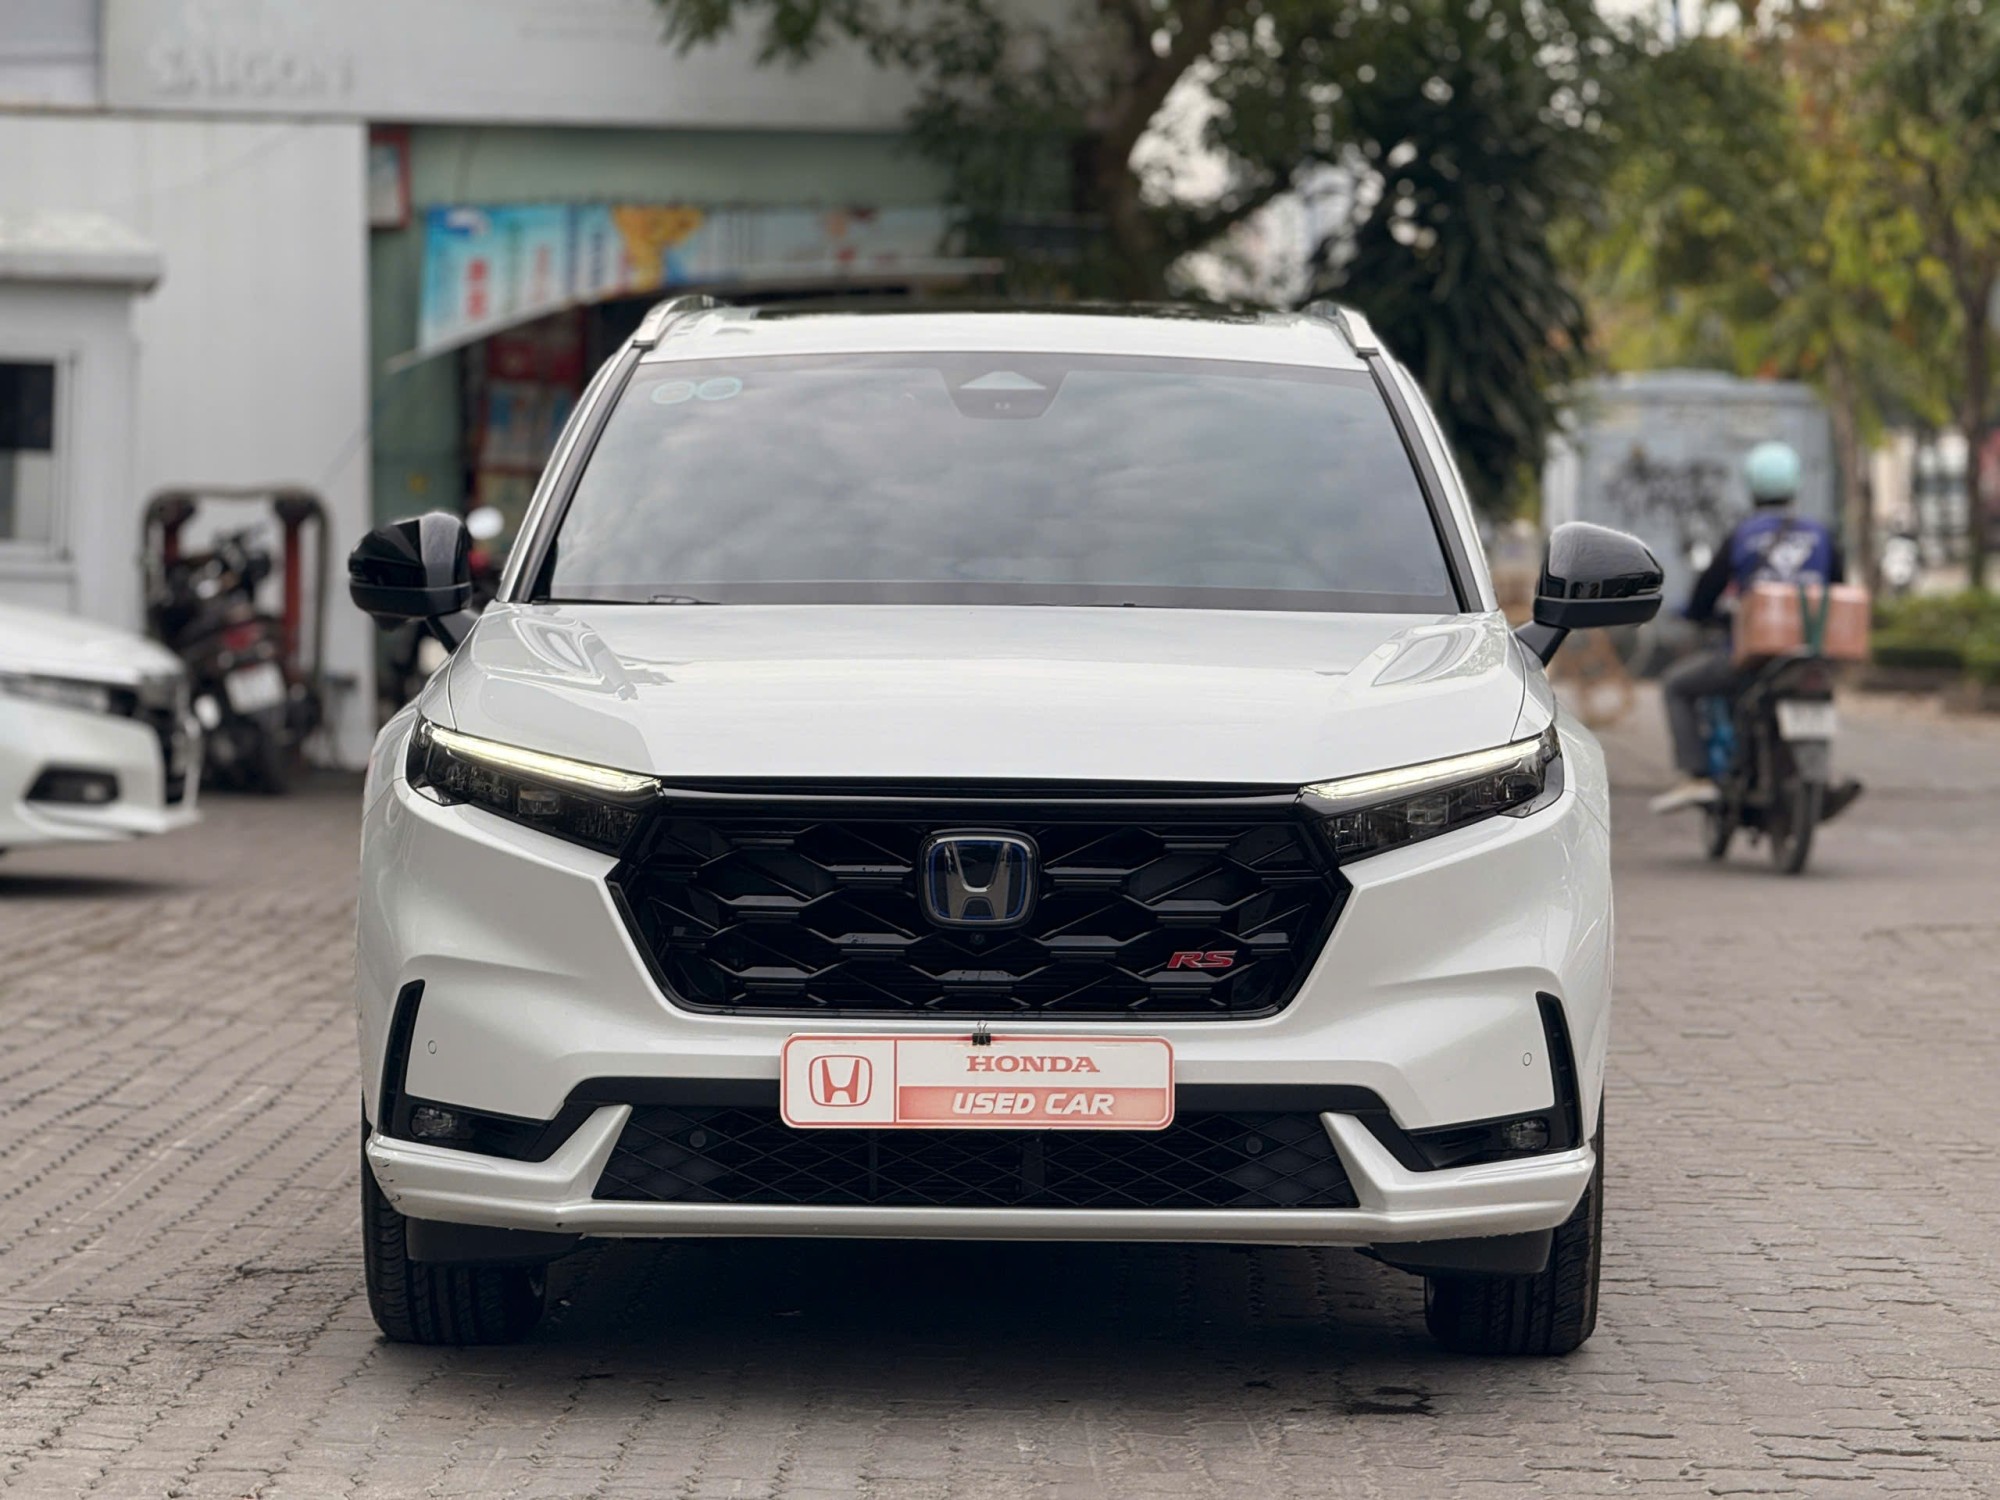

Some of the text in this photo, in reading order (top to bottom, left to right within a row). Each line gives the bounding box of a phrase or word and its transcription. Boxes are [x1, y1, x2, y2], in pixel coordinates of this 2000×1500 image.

[1167, 950, 1237, 968] RS
[966, 1056, 1100, 1072] HONDA
[952, 1093, 1116, 1115] USED CAR
